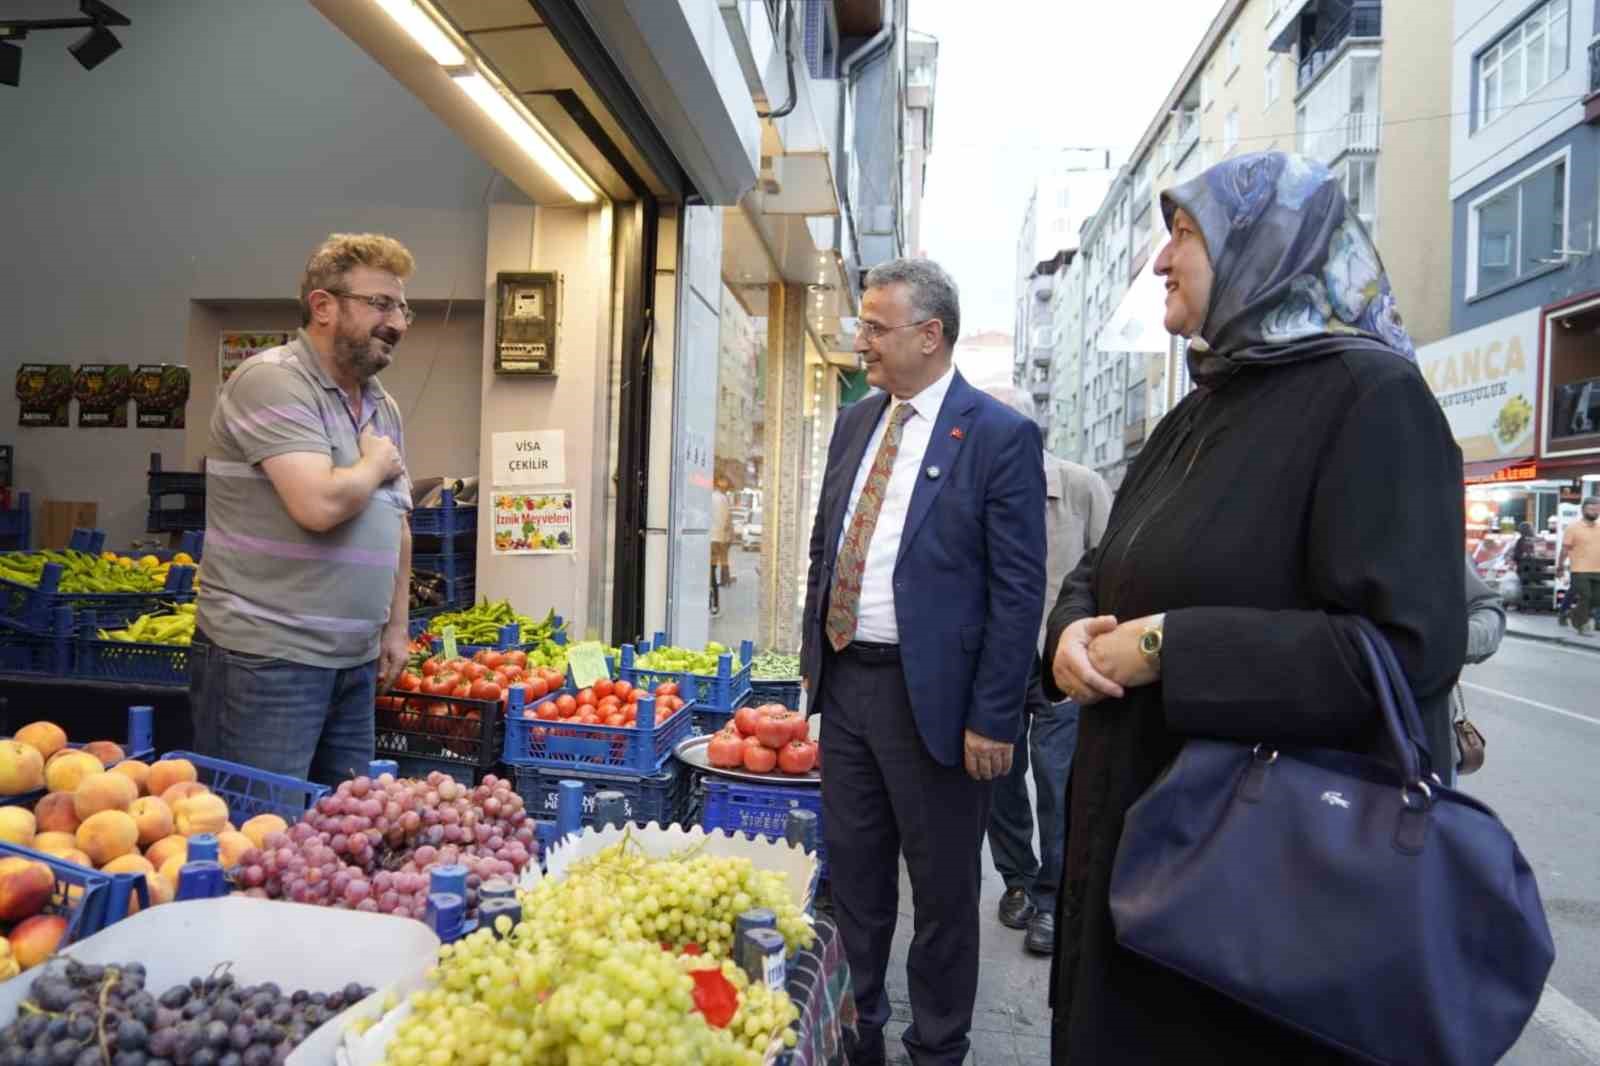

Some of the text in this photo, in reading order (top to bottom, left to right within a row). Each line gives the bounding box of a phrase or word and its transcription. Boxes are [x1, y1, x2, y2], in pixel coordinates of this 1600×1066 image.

[1424, 336, 1526, 391] KANCA
[516, 439, 541, 452] VİSA
[508, 458, 549, 472] ÇEKİLİR
